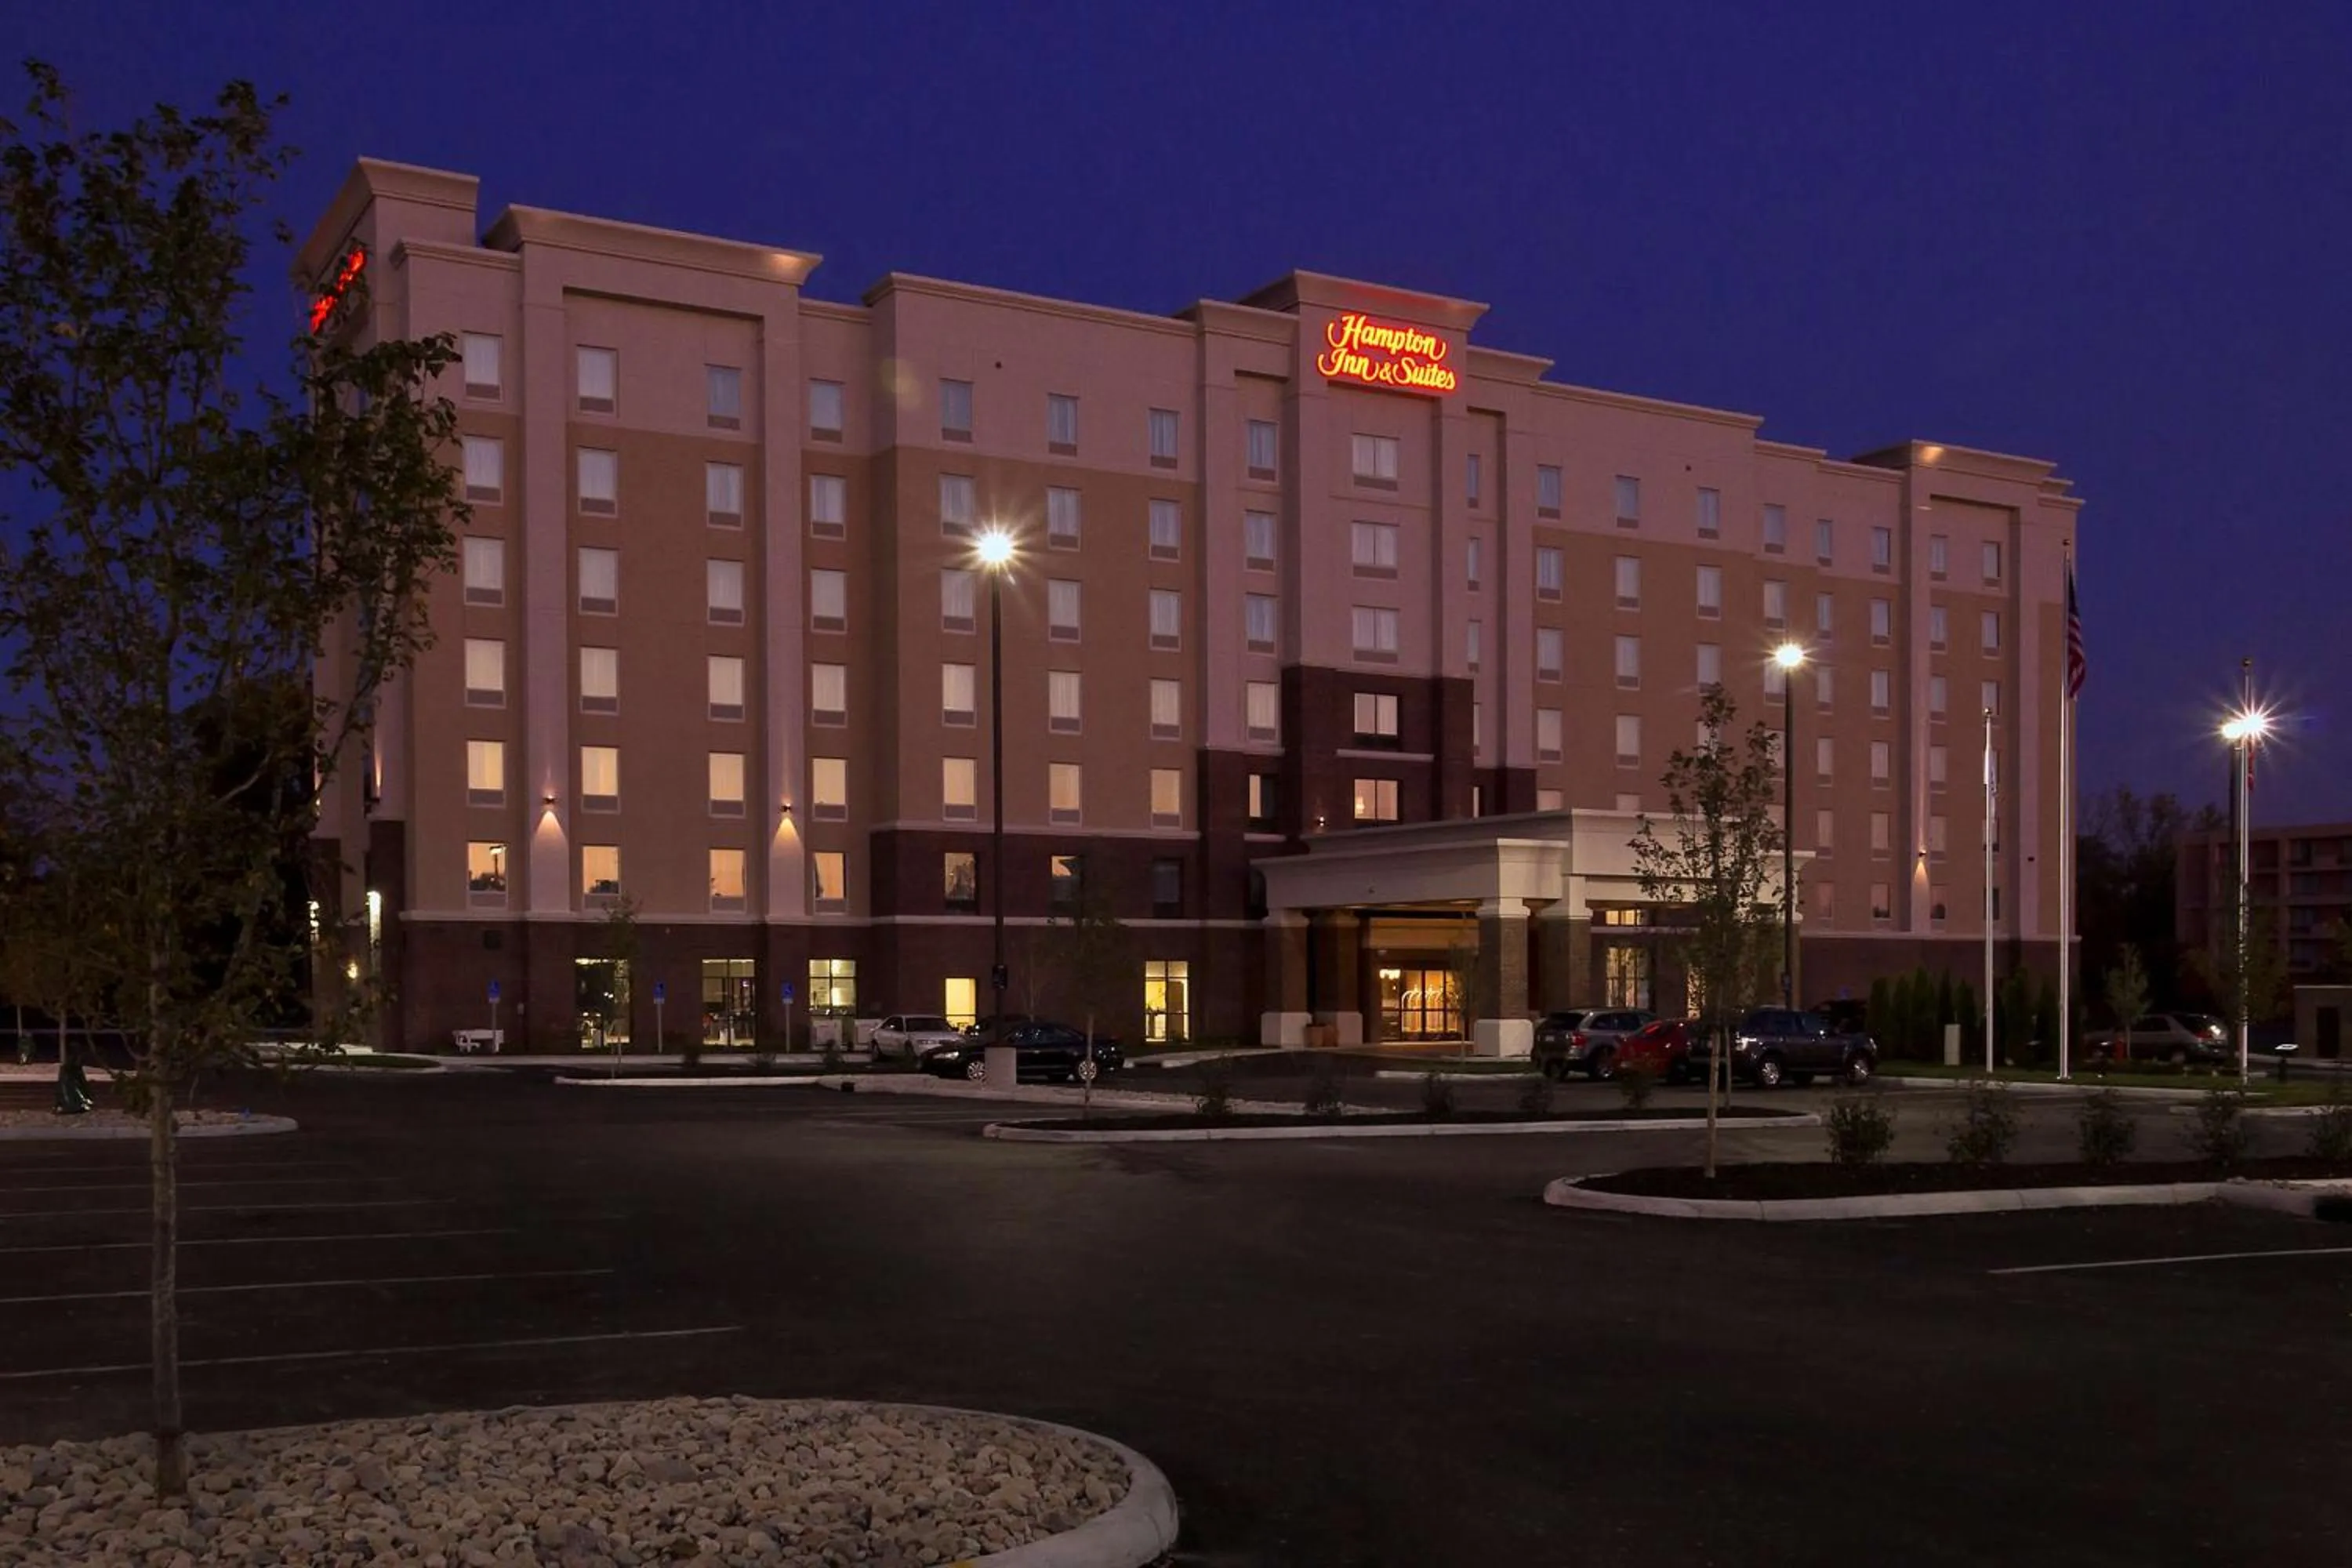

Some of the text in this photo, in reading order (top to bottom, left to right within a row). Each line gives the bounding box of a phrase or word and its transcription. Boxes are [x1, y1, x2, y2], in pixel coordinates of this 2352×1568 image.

[1327, 315, 1446, 360] Hampton
[1319, 349, 1455, 389] Inn & Suites
